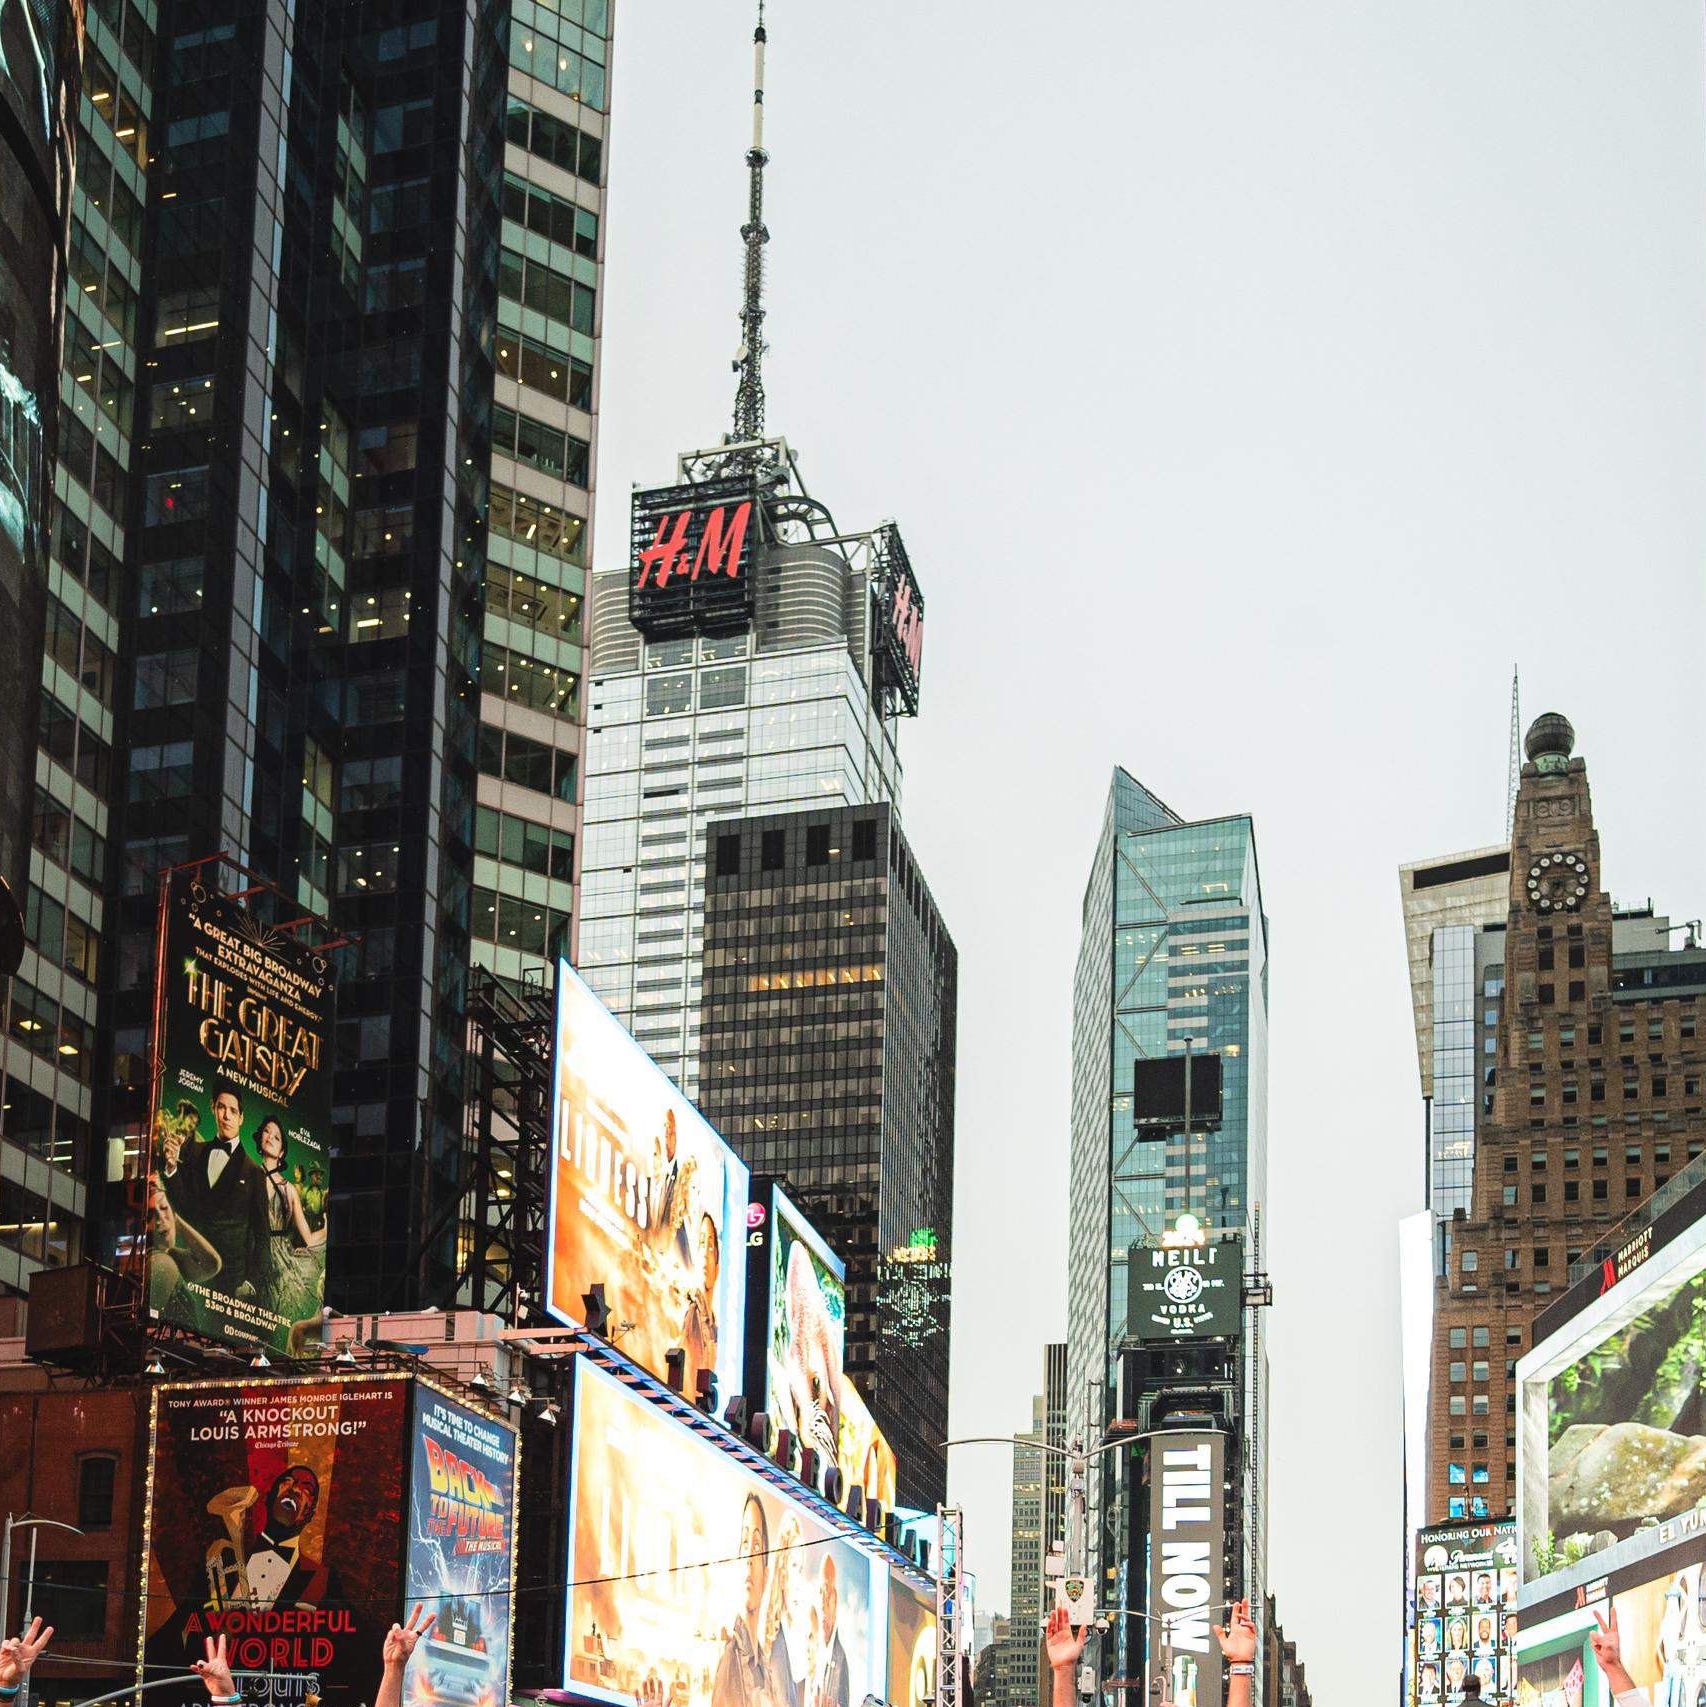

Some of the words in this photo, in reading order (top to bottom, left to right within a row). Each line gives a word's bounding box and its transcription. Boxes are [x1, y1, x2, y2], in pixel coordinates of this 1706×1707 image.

[638, 502, 752, 589] H&M
[196, 946, 213, 961] THAT
[249, 977, 266, 992] WITH
[267, 986, 280, 1000] LIFE
[280, 994, 294, 1007] AND
[217, 947, 302, 1001] EXTRAVAGANZA
[243, 947, 262, 964] BIG
[264, 957, 323, 999] BROADWAY
[188, 967, 234, 1024] THE
[239, 997, 325, 1071] GREAT
[199, 1018, 307, 1097] GATSBY
[178, 1078, 204, 1094] JORDAN
[179, 1069, 204, 1085] JEREMY
[216, 1064, 225, 1075] A
[227, 1069, 247, 1086] NEW
[249, 1080, 289, 1107] MUSICAL
[299, 1127, 311, 1138] EVA
[1618, 1226, 1652, 1262] MARRIOTT
[1618, 1245, 1649, 1278] MARQUIS
[213, 1288, 257, 1314] BROADWAY
[258, 1308, 292, 1328] THEATRE
[225, 1307, 232, 1316] &
[234, 1309, 278, 1332] BROADWAY
[1160, 1303, 1205, 1314] VODKA
[233, 1398, 268, 1406] WINNER
[269, 1395, 297, 1405] JAMES
[299, 1394, 338, 1403] MONROE
[339, 1392, 384, 1401] IGLEHART
[385, 1391, 393, 1400] IS
[243, 1405, 339, 1423] KNOCKOUT
[191, 1426, 239, 1441] LOUIS
[245, 1420, 367, 1439] ARMSTRONG!”
[422, 1412, 452, 1438] MUSICAL
[453, 1428, 483, 1452] THEATER
[483, 1441, 509, 1465] HISTORY
[448, 1411, 464, 1428] TIME
[463, 1418, 474, 1432] TO
[474, 1424, 500, 1448] CHANGE
[423, 1434, 504, 1509] BACK
[1162, 1444, 1211, 1530] TILL
[431, 1493, 447, 1518] TO
[446, 1499, 504, 1537] FUTURE
[465, 1540, 478, 1551] THE
[479, 1540, 503, 1551] MUSICAL
[1421, 1531, 1470, 1544] HONORING
[1471, 1528, 1493, 1540] OUR
[1659, 1524, 1677, 1544] EL
[1161, 1541, 1211, 1654] NOW
[184, 1612, 202, 1634] A
[207, 1610, 356, 1633] WONDERFUL
